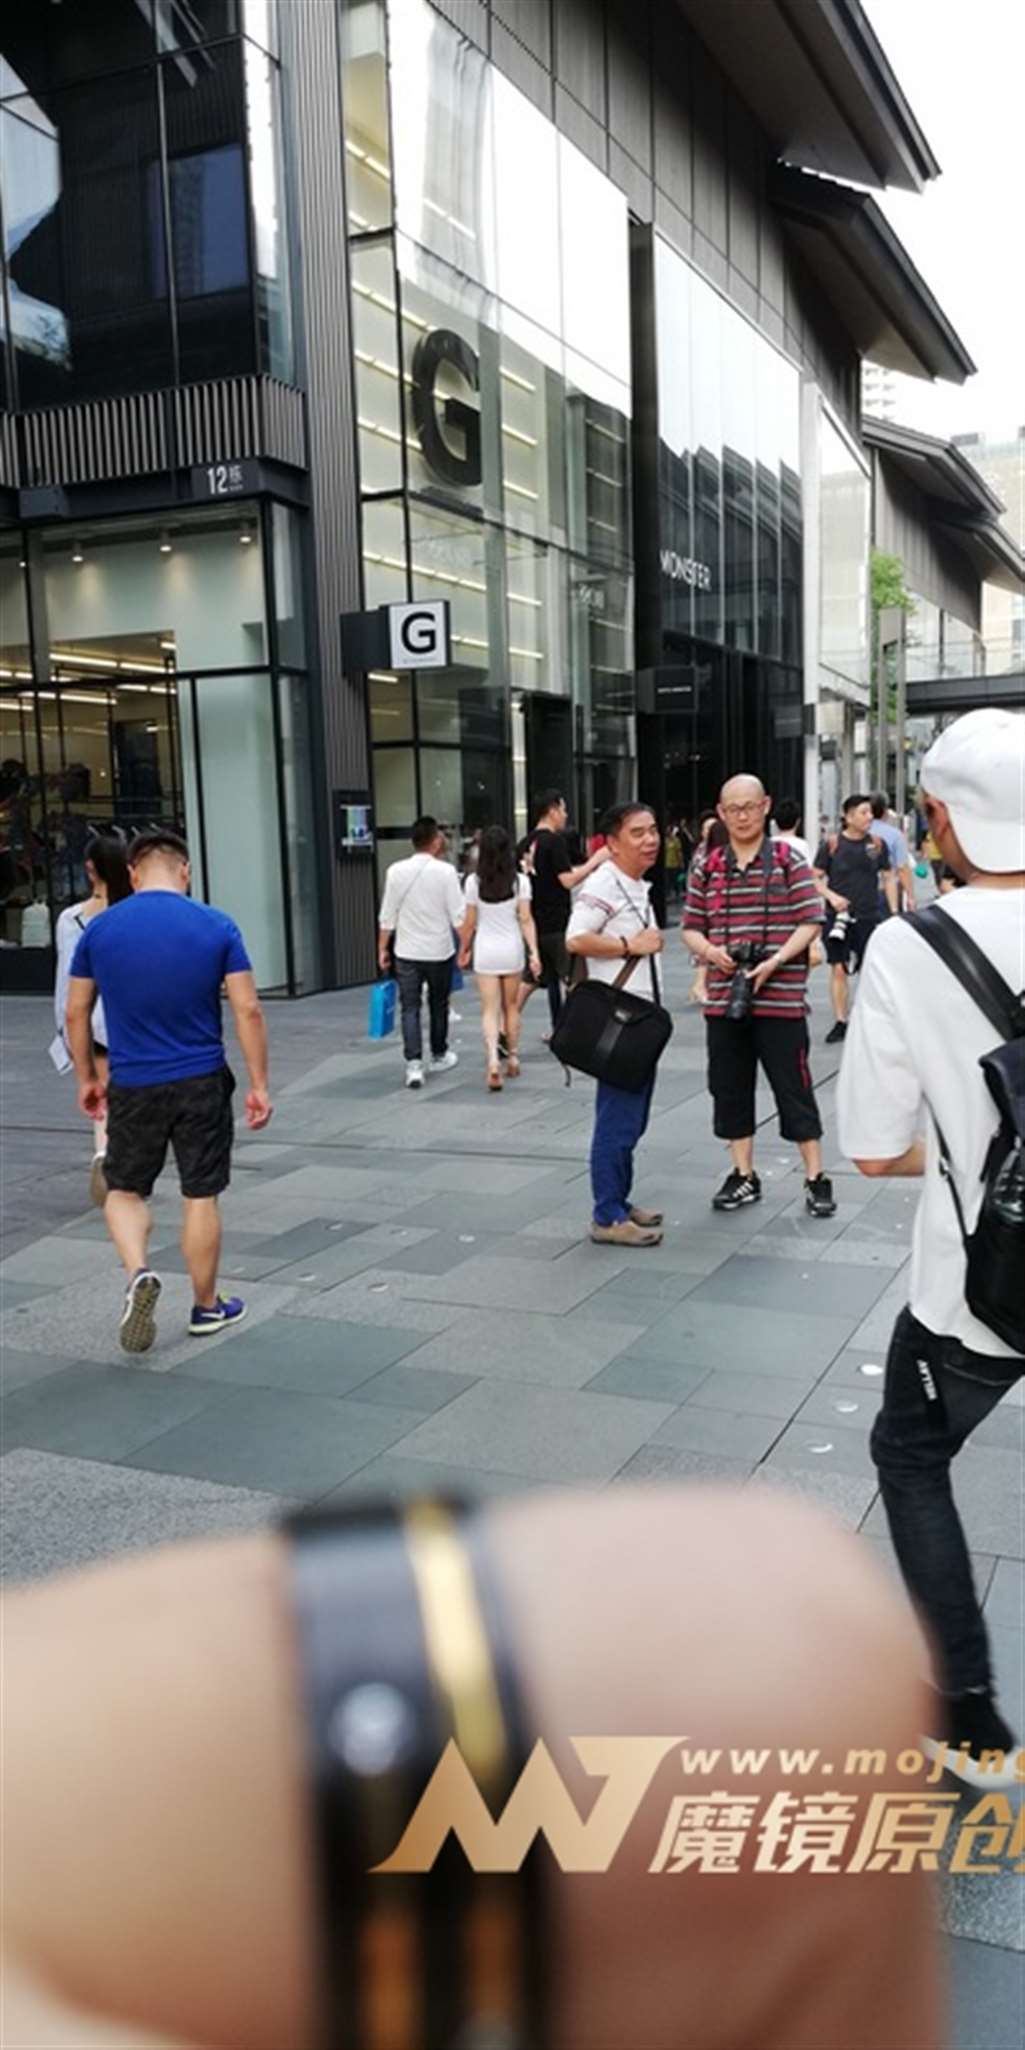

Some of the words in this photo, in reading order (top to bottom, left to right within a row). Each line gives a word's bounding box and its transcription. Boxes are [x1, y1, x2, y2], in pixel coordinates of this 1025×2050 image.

[412, 328, 482, 487] G
[660, 549, 712, 592] MONSTER
[401, 611, 436, 654] G
